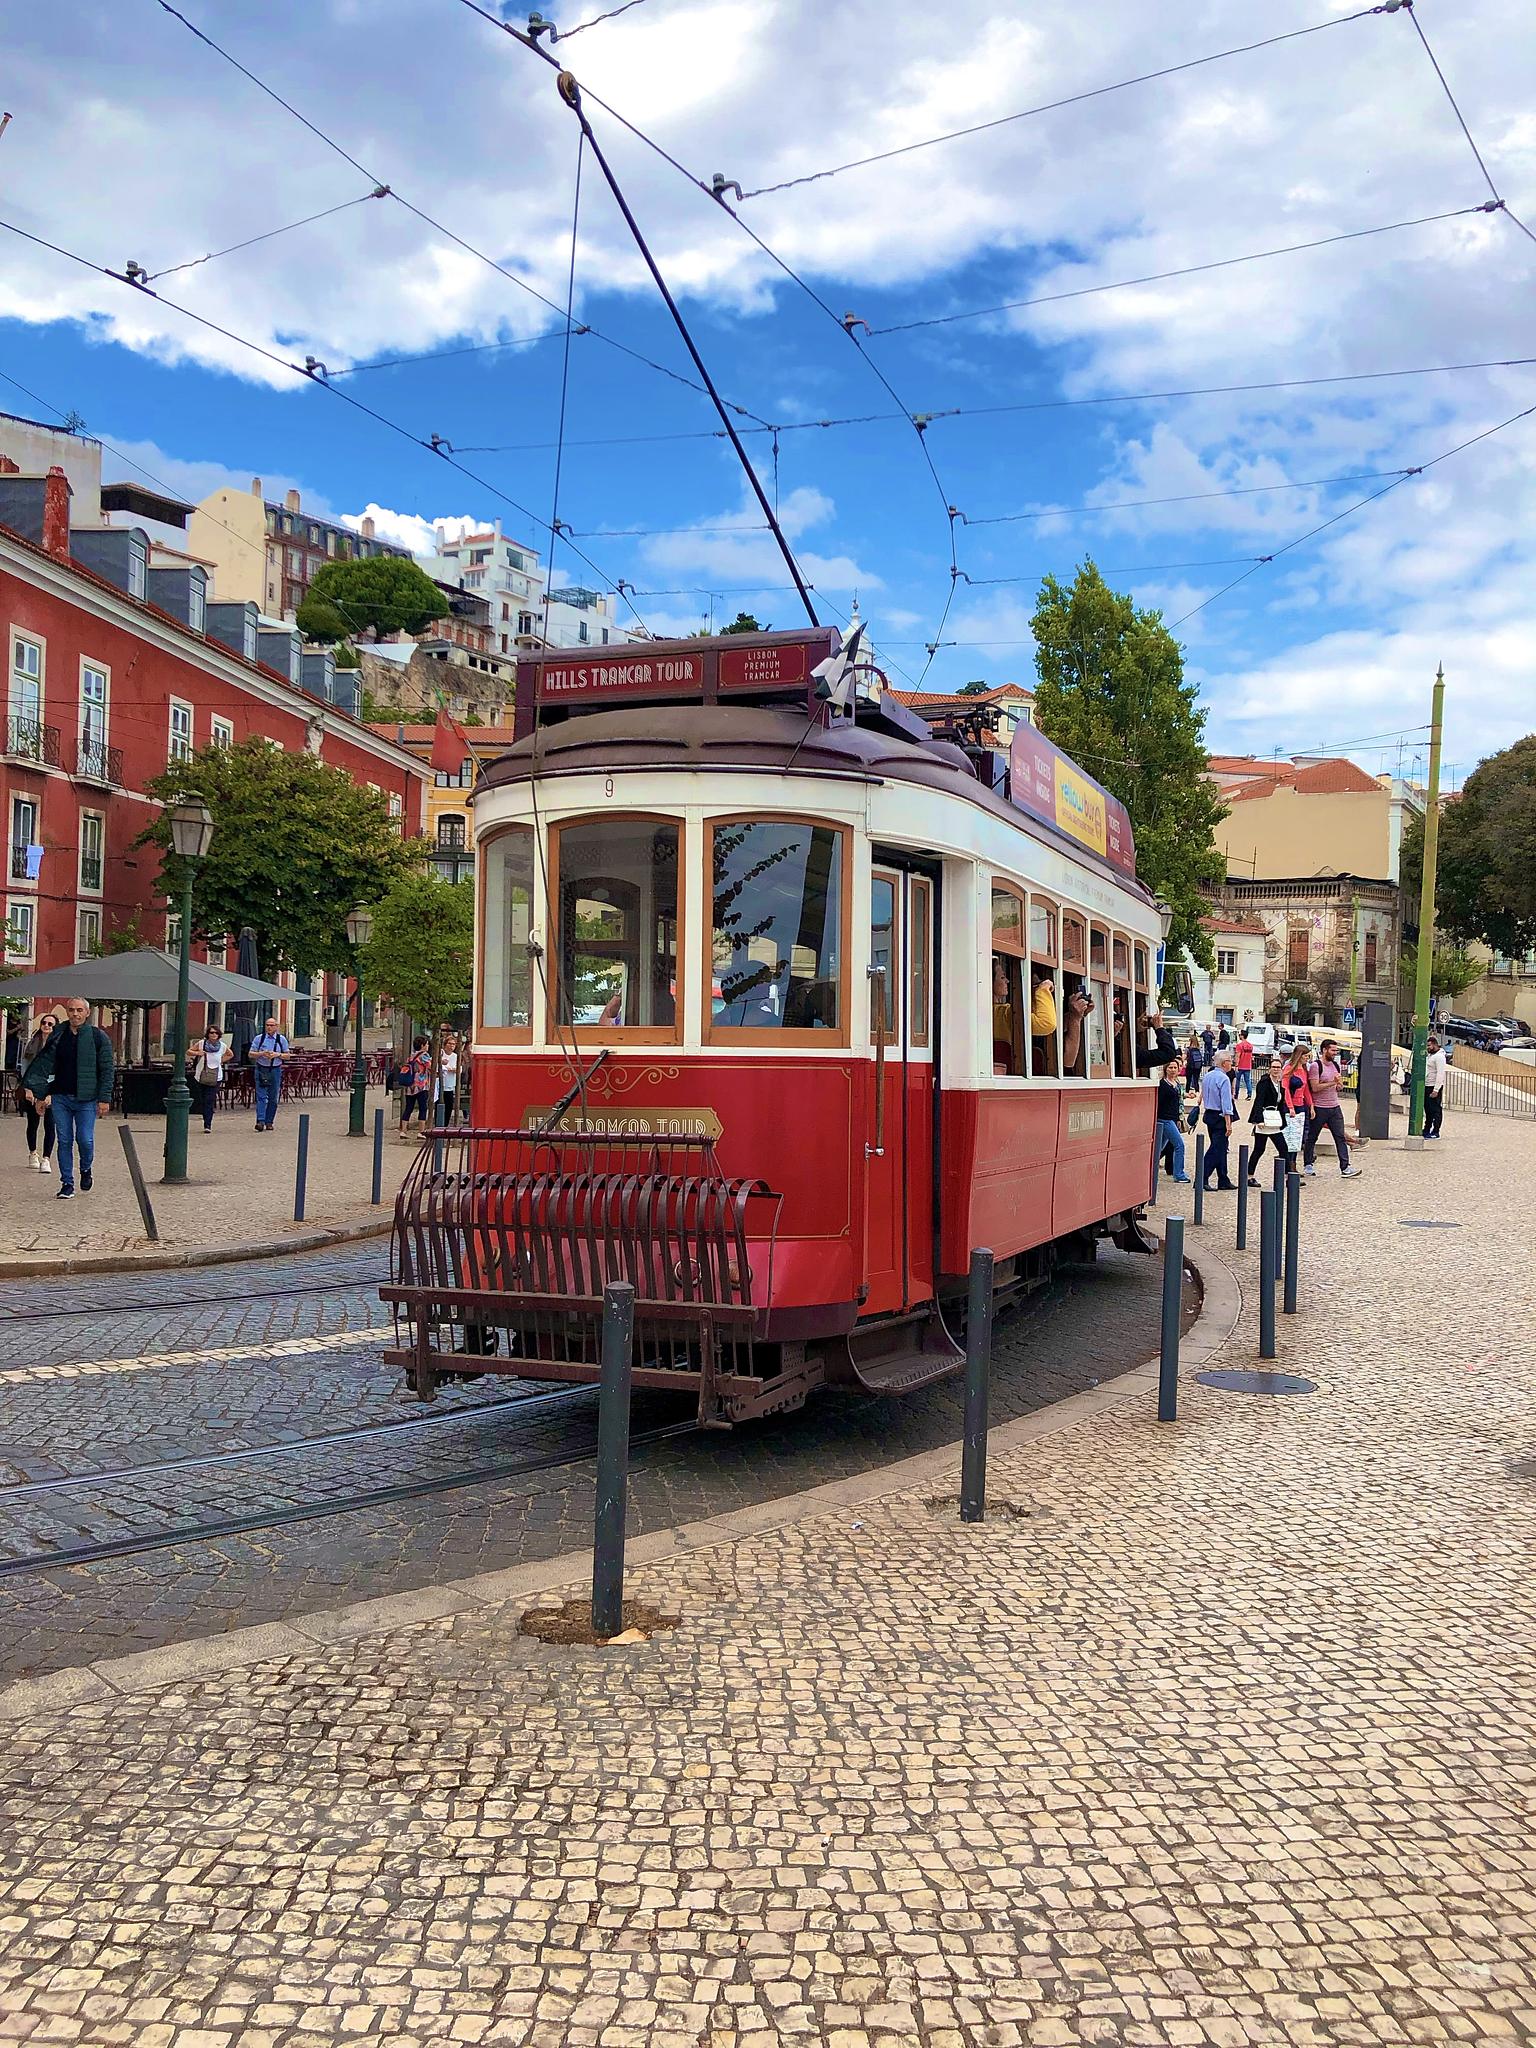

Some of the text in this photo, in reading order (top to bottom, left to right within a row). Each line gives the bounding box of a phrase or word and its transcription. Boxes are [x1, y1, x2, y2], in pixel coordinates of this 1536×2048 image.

[747, 650, 777, 661] LISBON
[744, 660, 780, 670] PREMIUM
[545, 661, 694, 691] HILLS TRAMCAR TOUR
[744, 671, 780, 681] TRAMCAR
[1034, 754, 1051, 781] TICKETS
[605, 778, 614, 797] 9
